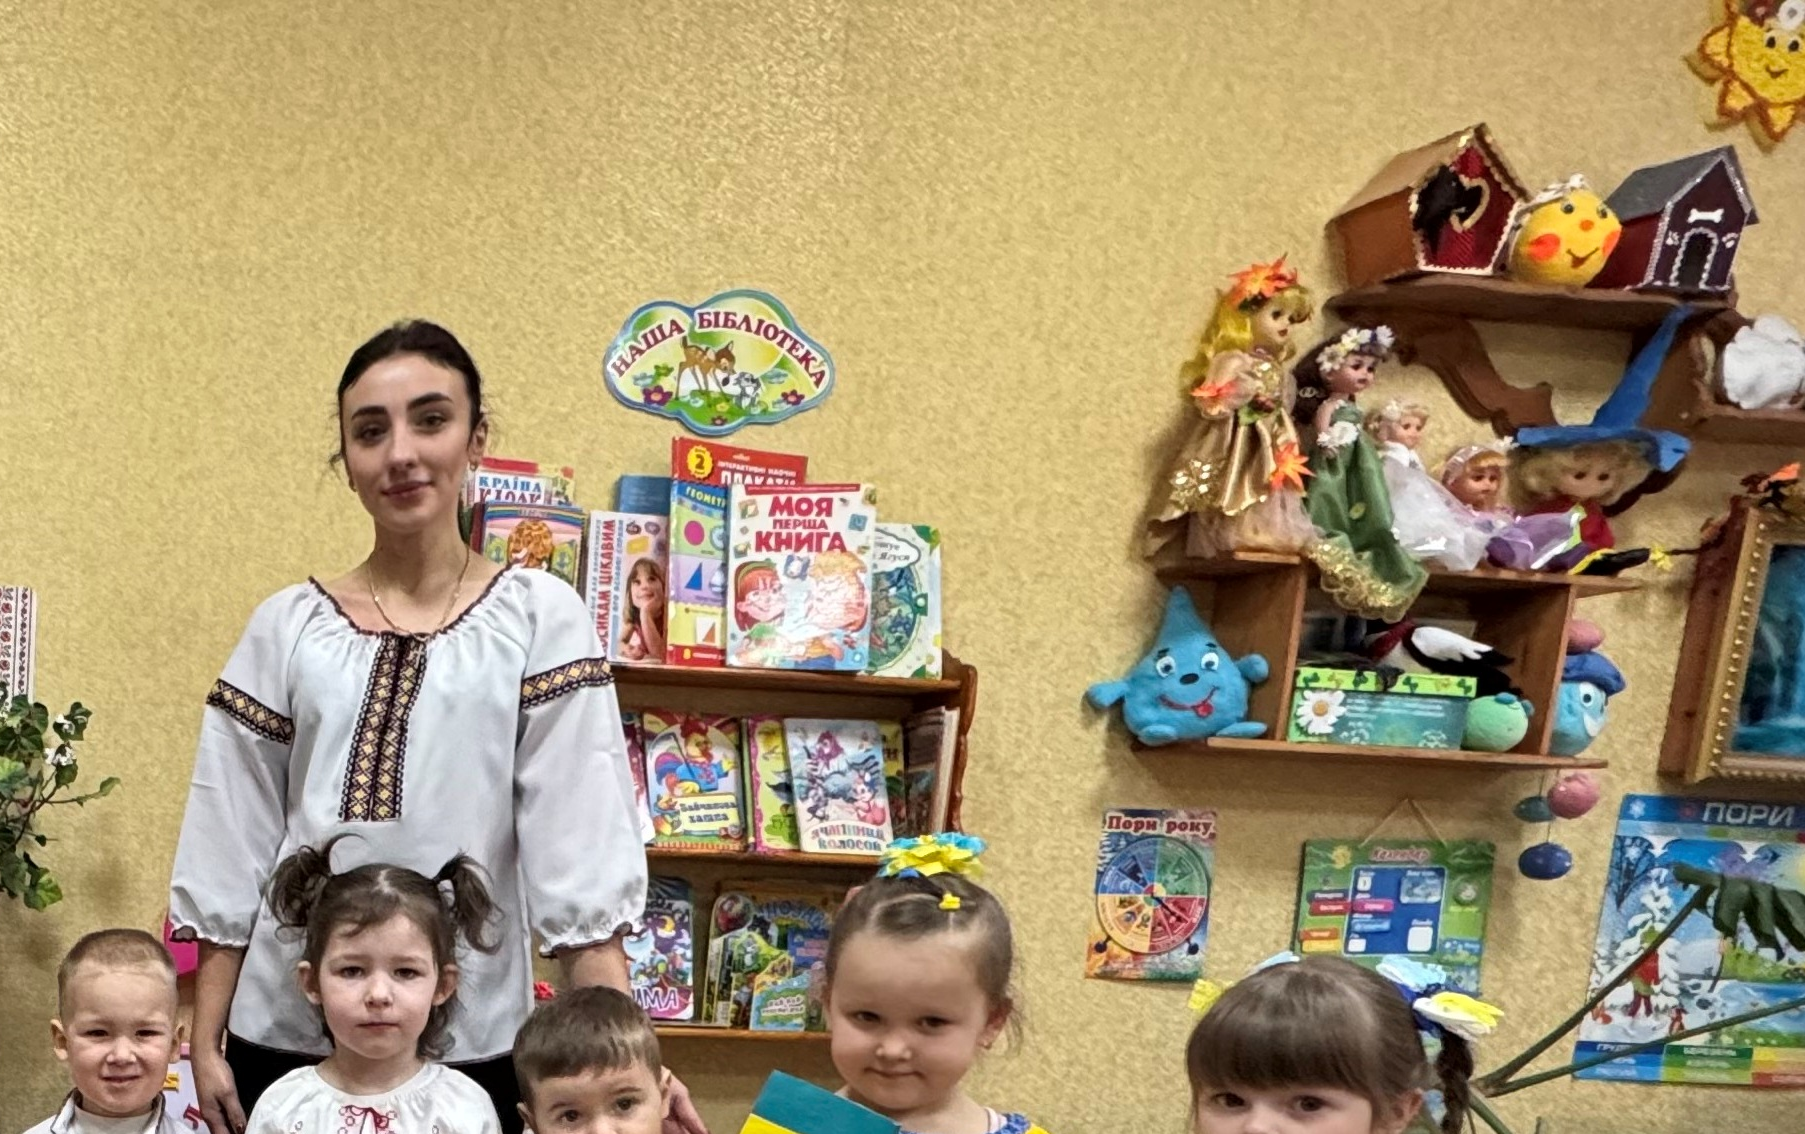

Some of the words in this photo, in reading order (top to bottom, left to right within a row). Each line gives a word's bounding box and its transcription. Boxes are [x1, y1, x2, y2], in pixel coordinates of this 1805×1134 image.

[610, 319, 686, 378] НАША
[697, 311, 827, 389] БІБЛІОТЕКА
[695, 454, 705, 469] 2
[479, 476, 542, 493] КРАЇНА
[768, 496, 833, 517] МОЯ
[773, 519, 828, 530] ПЕРША
[598, 519, 616, 585] ЦІКАВИМ
[755, 531, 847, 552] КНИГА
[1702, 802, 1795, 826] ПОРИ
[1107, 815, 1157, 833] Пори
[1165, 819, 1213, 838] року
